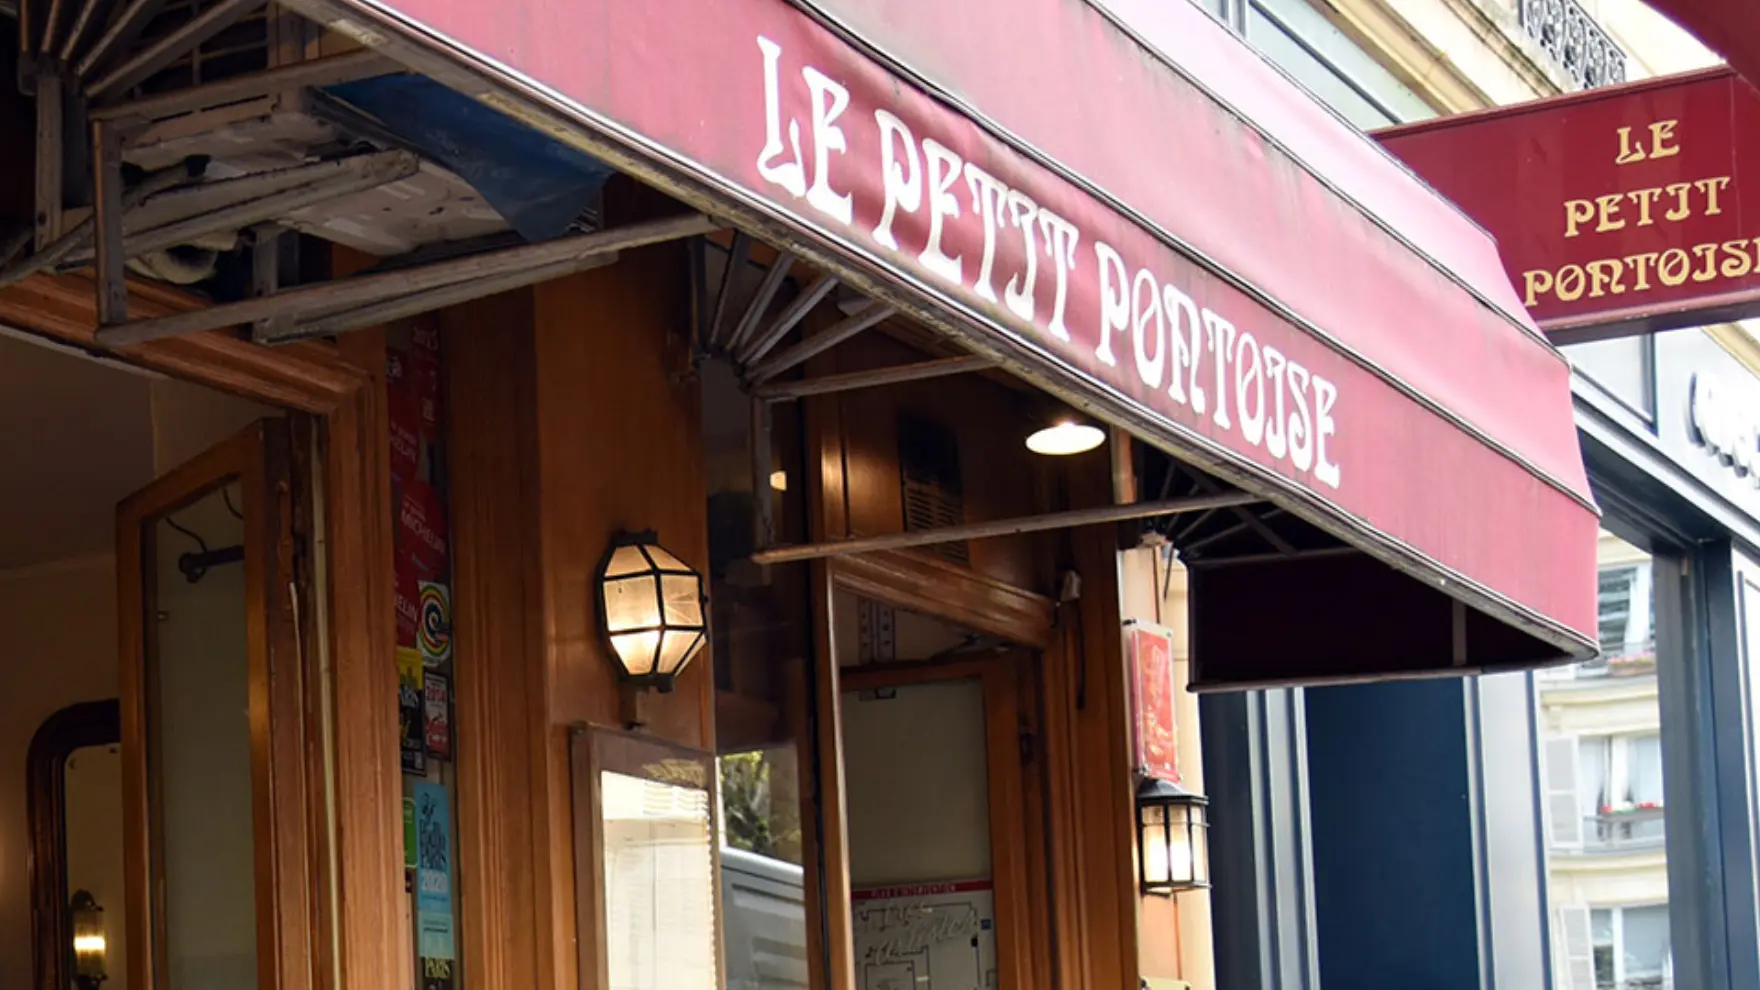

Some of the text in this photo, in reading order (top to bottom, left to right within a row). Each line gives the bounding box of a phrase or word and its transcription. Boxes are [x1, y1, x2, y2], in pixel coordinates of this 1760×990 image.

[1615, 119, 1680, 164] LE
[1563, 176, 1731, 238] PETIT
[756, 35, 1340, 488] LE PETIT PONTOISE
